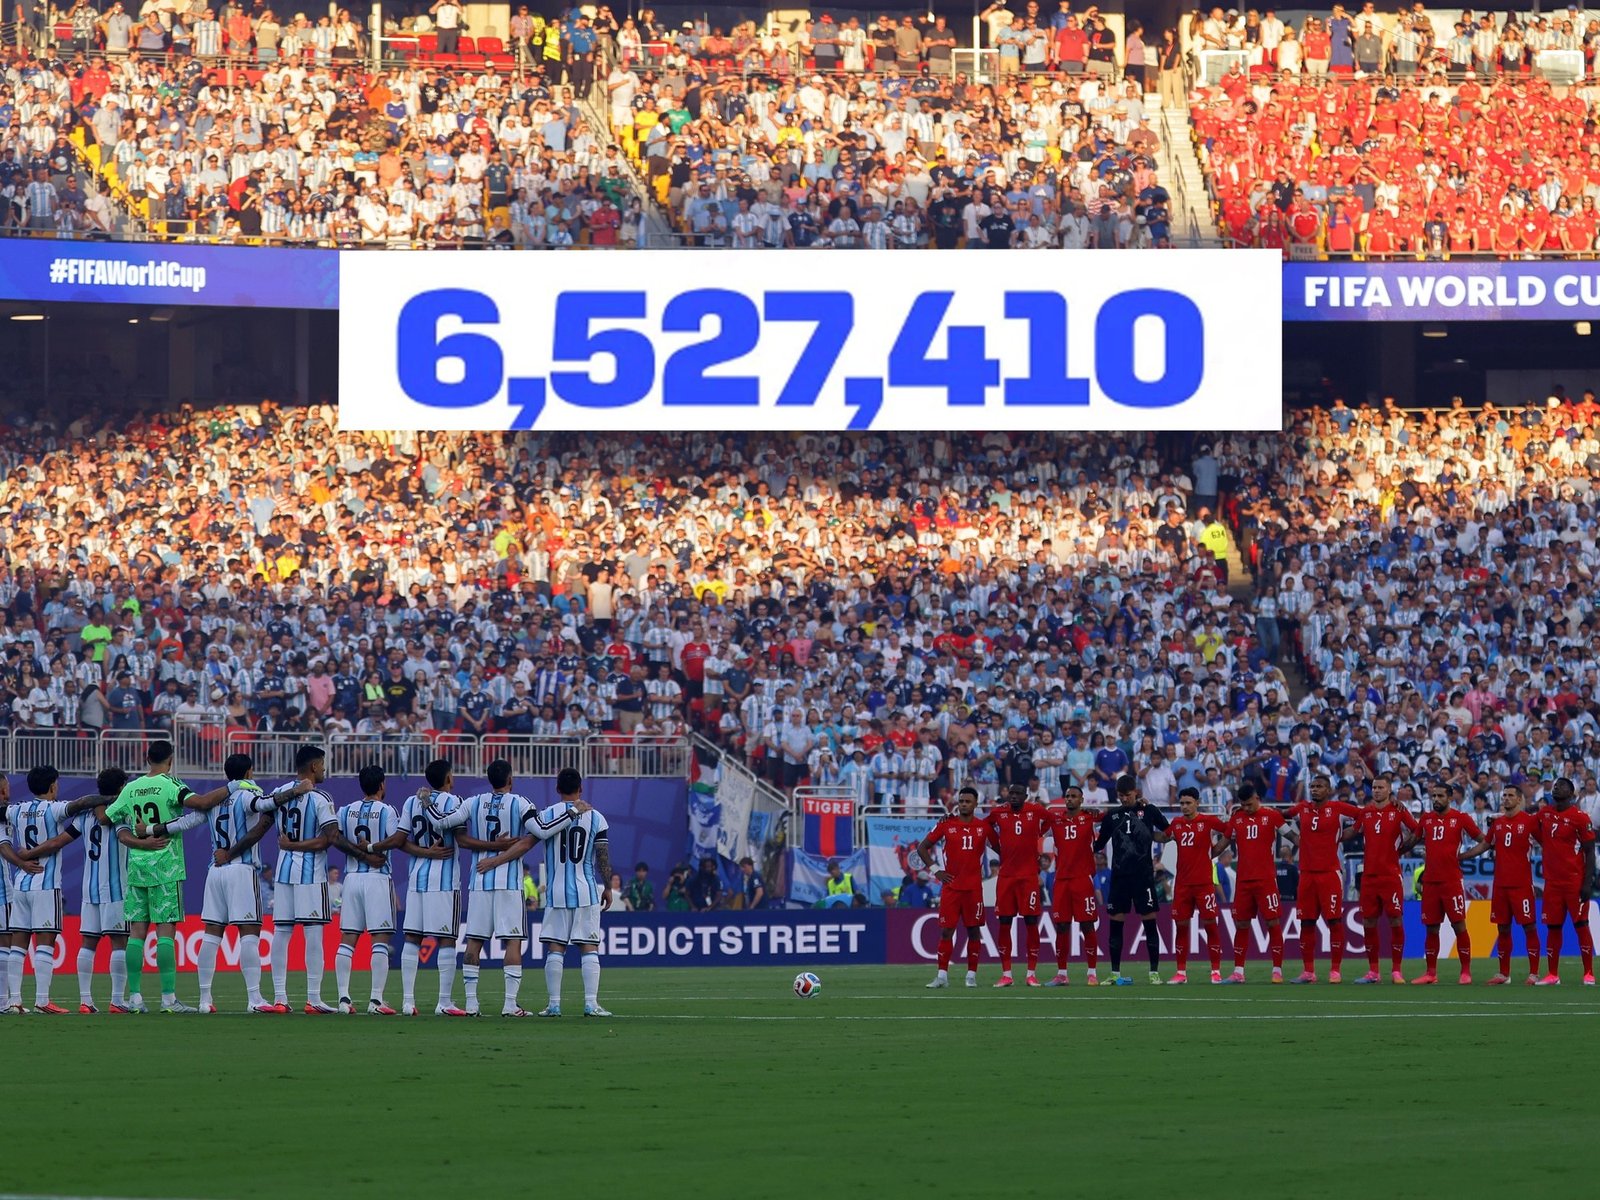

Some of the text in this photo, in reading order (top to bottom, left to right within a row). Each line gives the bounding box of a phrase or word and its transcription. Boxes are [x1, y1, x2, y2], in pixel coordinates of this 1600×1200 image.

[49, 258, 206, 292] #FIFAWorldCup
[1304, 276, 1392, 307] FIFA
[1397, 275, 1547, 307] WORLD
[806, 800, 850, 814] TIGRE
[1015, 820, 1022, 835] 6
[1125, 819, 1132, 834] 1
[1311, 816, 1320, 831] 5
[1374, 819, 1381, 834] 4
[1550, 823, 1559, 838] 7
[215, 813, 231, 851] 5
[1064, 824, 1077, 840] 15
[1180, 831, 1195, 847] 22
[1246, 824, 1258, 840] 10
[1432, 825, 1445, 841] 13
[1504, 832, 1512, 847] 8
[88, 824, 103, 862] 9
[560, 826, 586, 865] 10
[961, 835, 973, 850] 11
[1029, 891, 1037, 905] 6
[1146, 887, 1154, 903] 1
[1204, 893, 1217, 910] 22
[1266, 893, 1279, 909] 10
[1330, 894, 1338, 908] 5
[1392, 892, 1400, 907] 4
[1452, 895, 1465, 911] 13
[1084, 896, 1097, 912] 15
[1522, 898, 1531, 913] 8
[580, 924, 865, 956] EDICTSTREET
[142, 930, 273, 968] enovo
